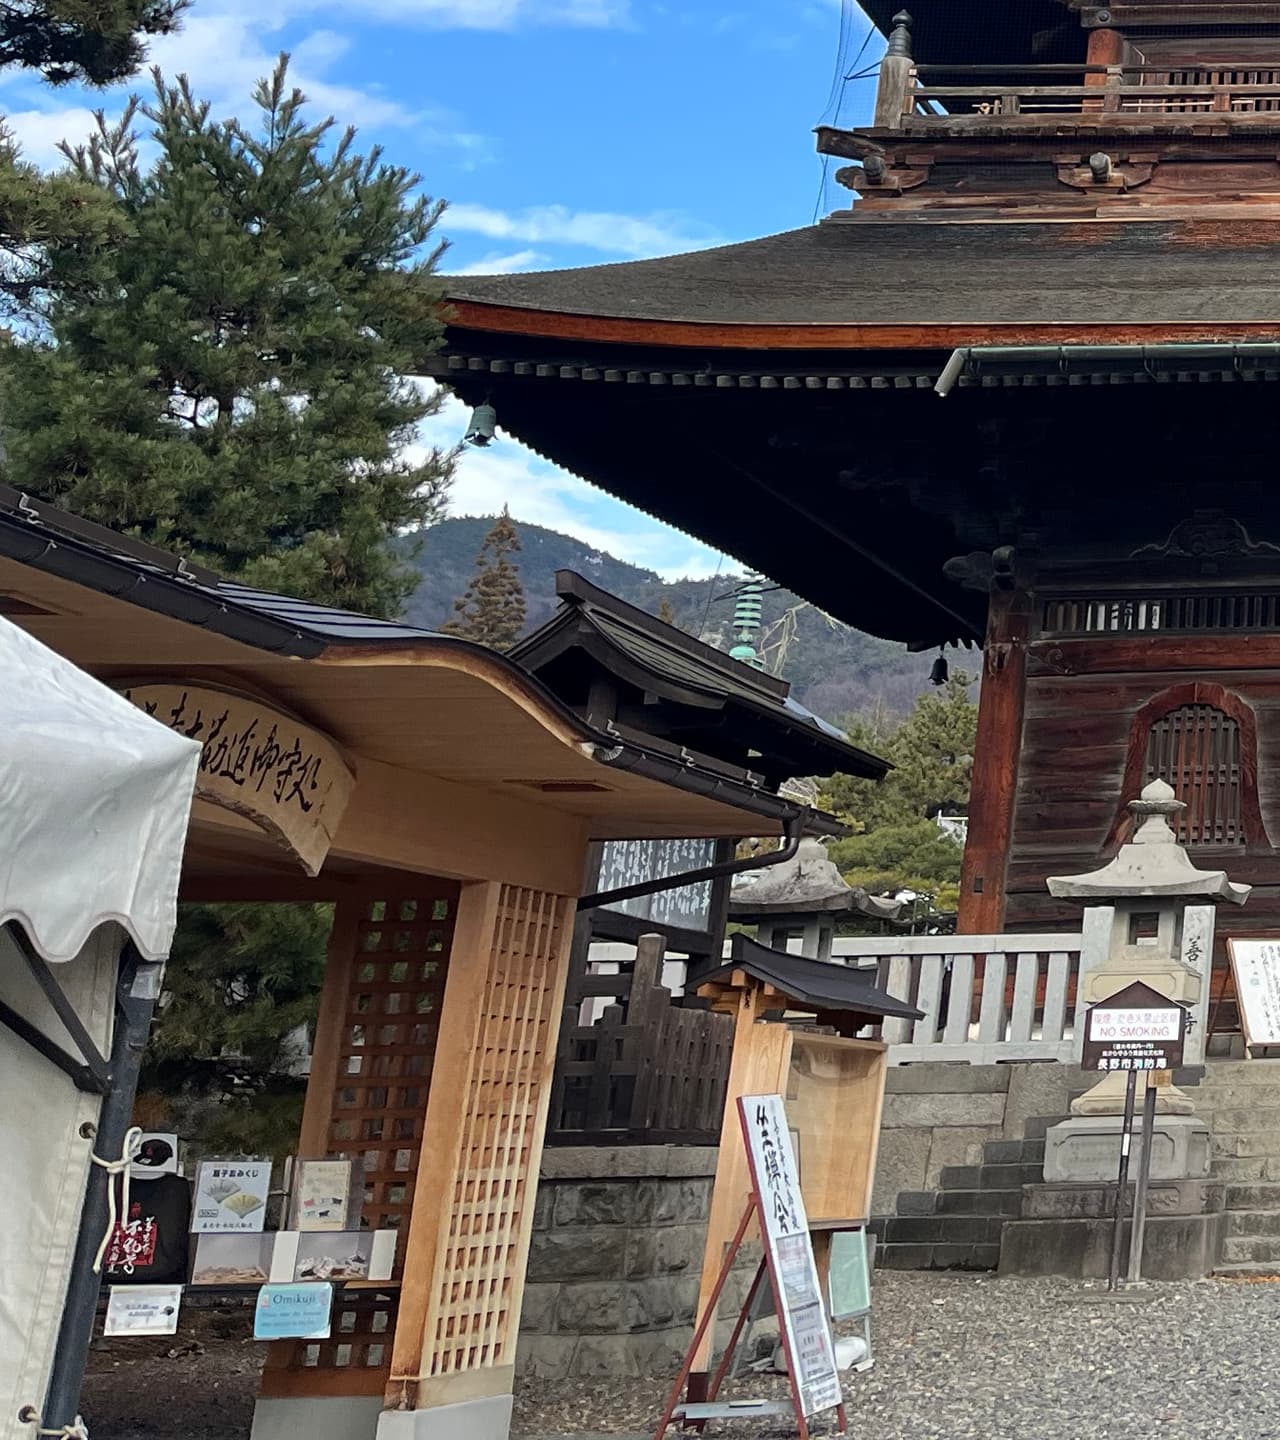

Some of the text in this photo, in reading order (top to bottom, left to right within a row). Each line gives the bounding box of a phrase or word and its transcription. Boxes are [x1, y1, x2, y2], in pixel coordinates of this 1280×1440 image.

[1100, 1026, 1169, 1037] NO SMOKING
[1097, 1057, 1168, 1070] 長野市消防局
[272, 1293, 316, 1305] Omikuji
